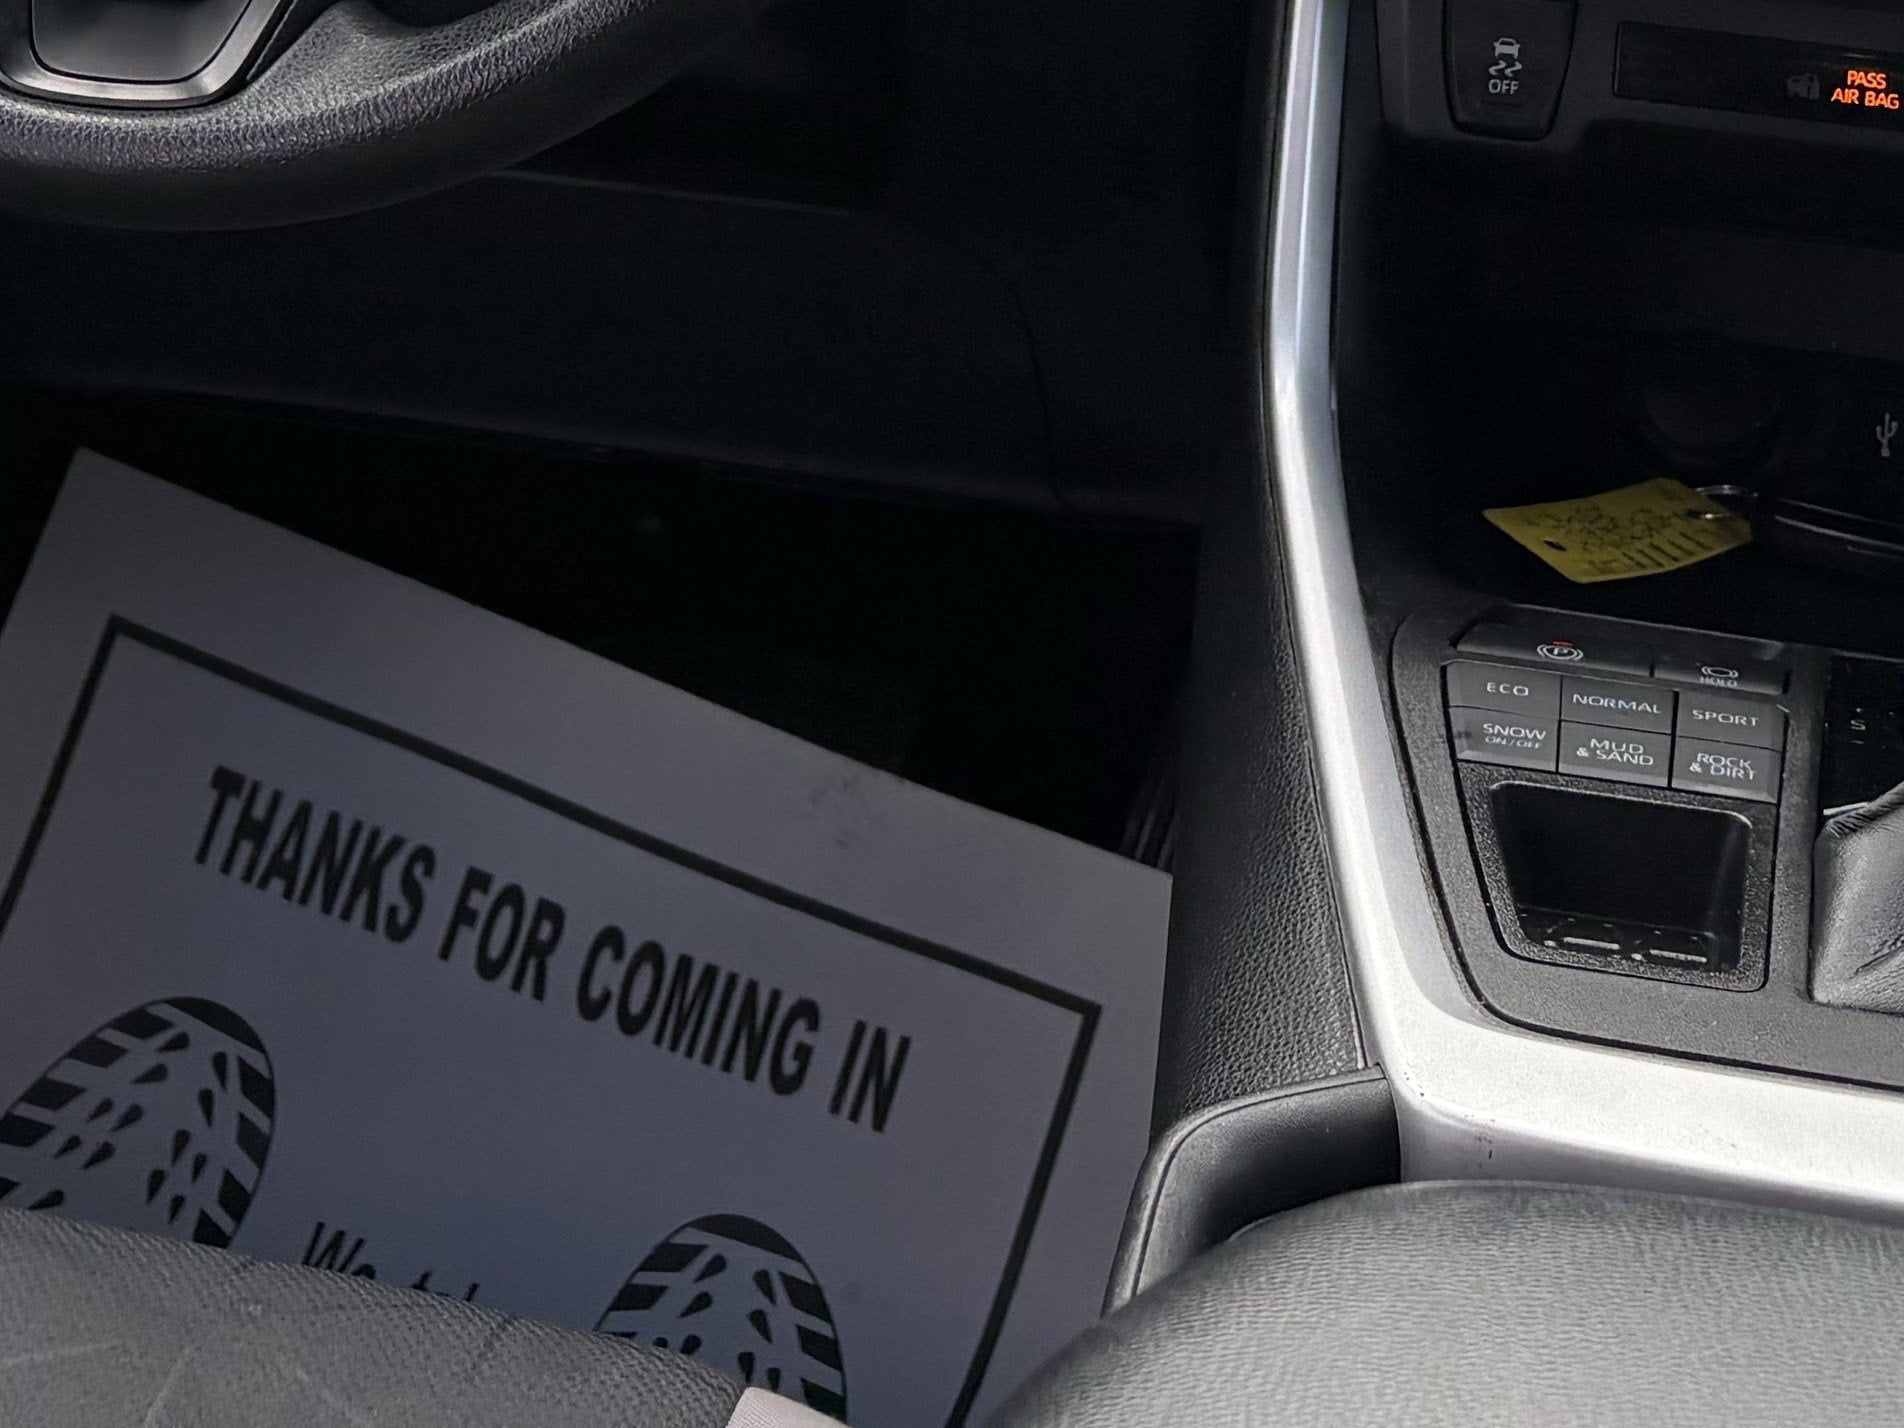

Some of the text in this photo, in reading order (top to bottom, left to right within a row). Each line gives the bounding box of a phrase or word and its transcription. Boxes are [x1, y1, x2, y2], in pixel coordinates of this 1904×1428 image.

[1488, 78, 1519, 96] OFF
[1846, 69, 1887, 90] PASS
[1830, 87, 1860, 105] AIR
[1863, 90, 1900, 110] BAG
[1486, 681, 1530, 696] ECO
[1699, 676, 1738, 688] HOLD
[1572, 693, 1661, 715] NORMAL
[1692, 709, 1759, 727] SPORT
[1482, 722, 1547, 741] SNOW
[1484, 735, 1542, 749] ON/OFF
[1590, 737, 1645, 755] MUD
[1576, 746, 1654, 766] & SAND
[1696, 751, 1753, 771] ROCK
[1689, 760, 1757, 781] & DIRT
[194, 765, 914, 1134] THANKS FOR COMING IN
